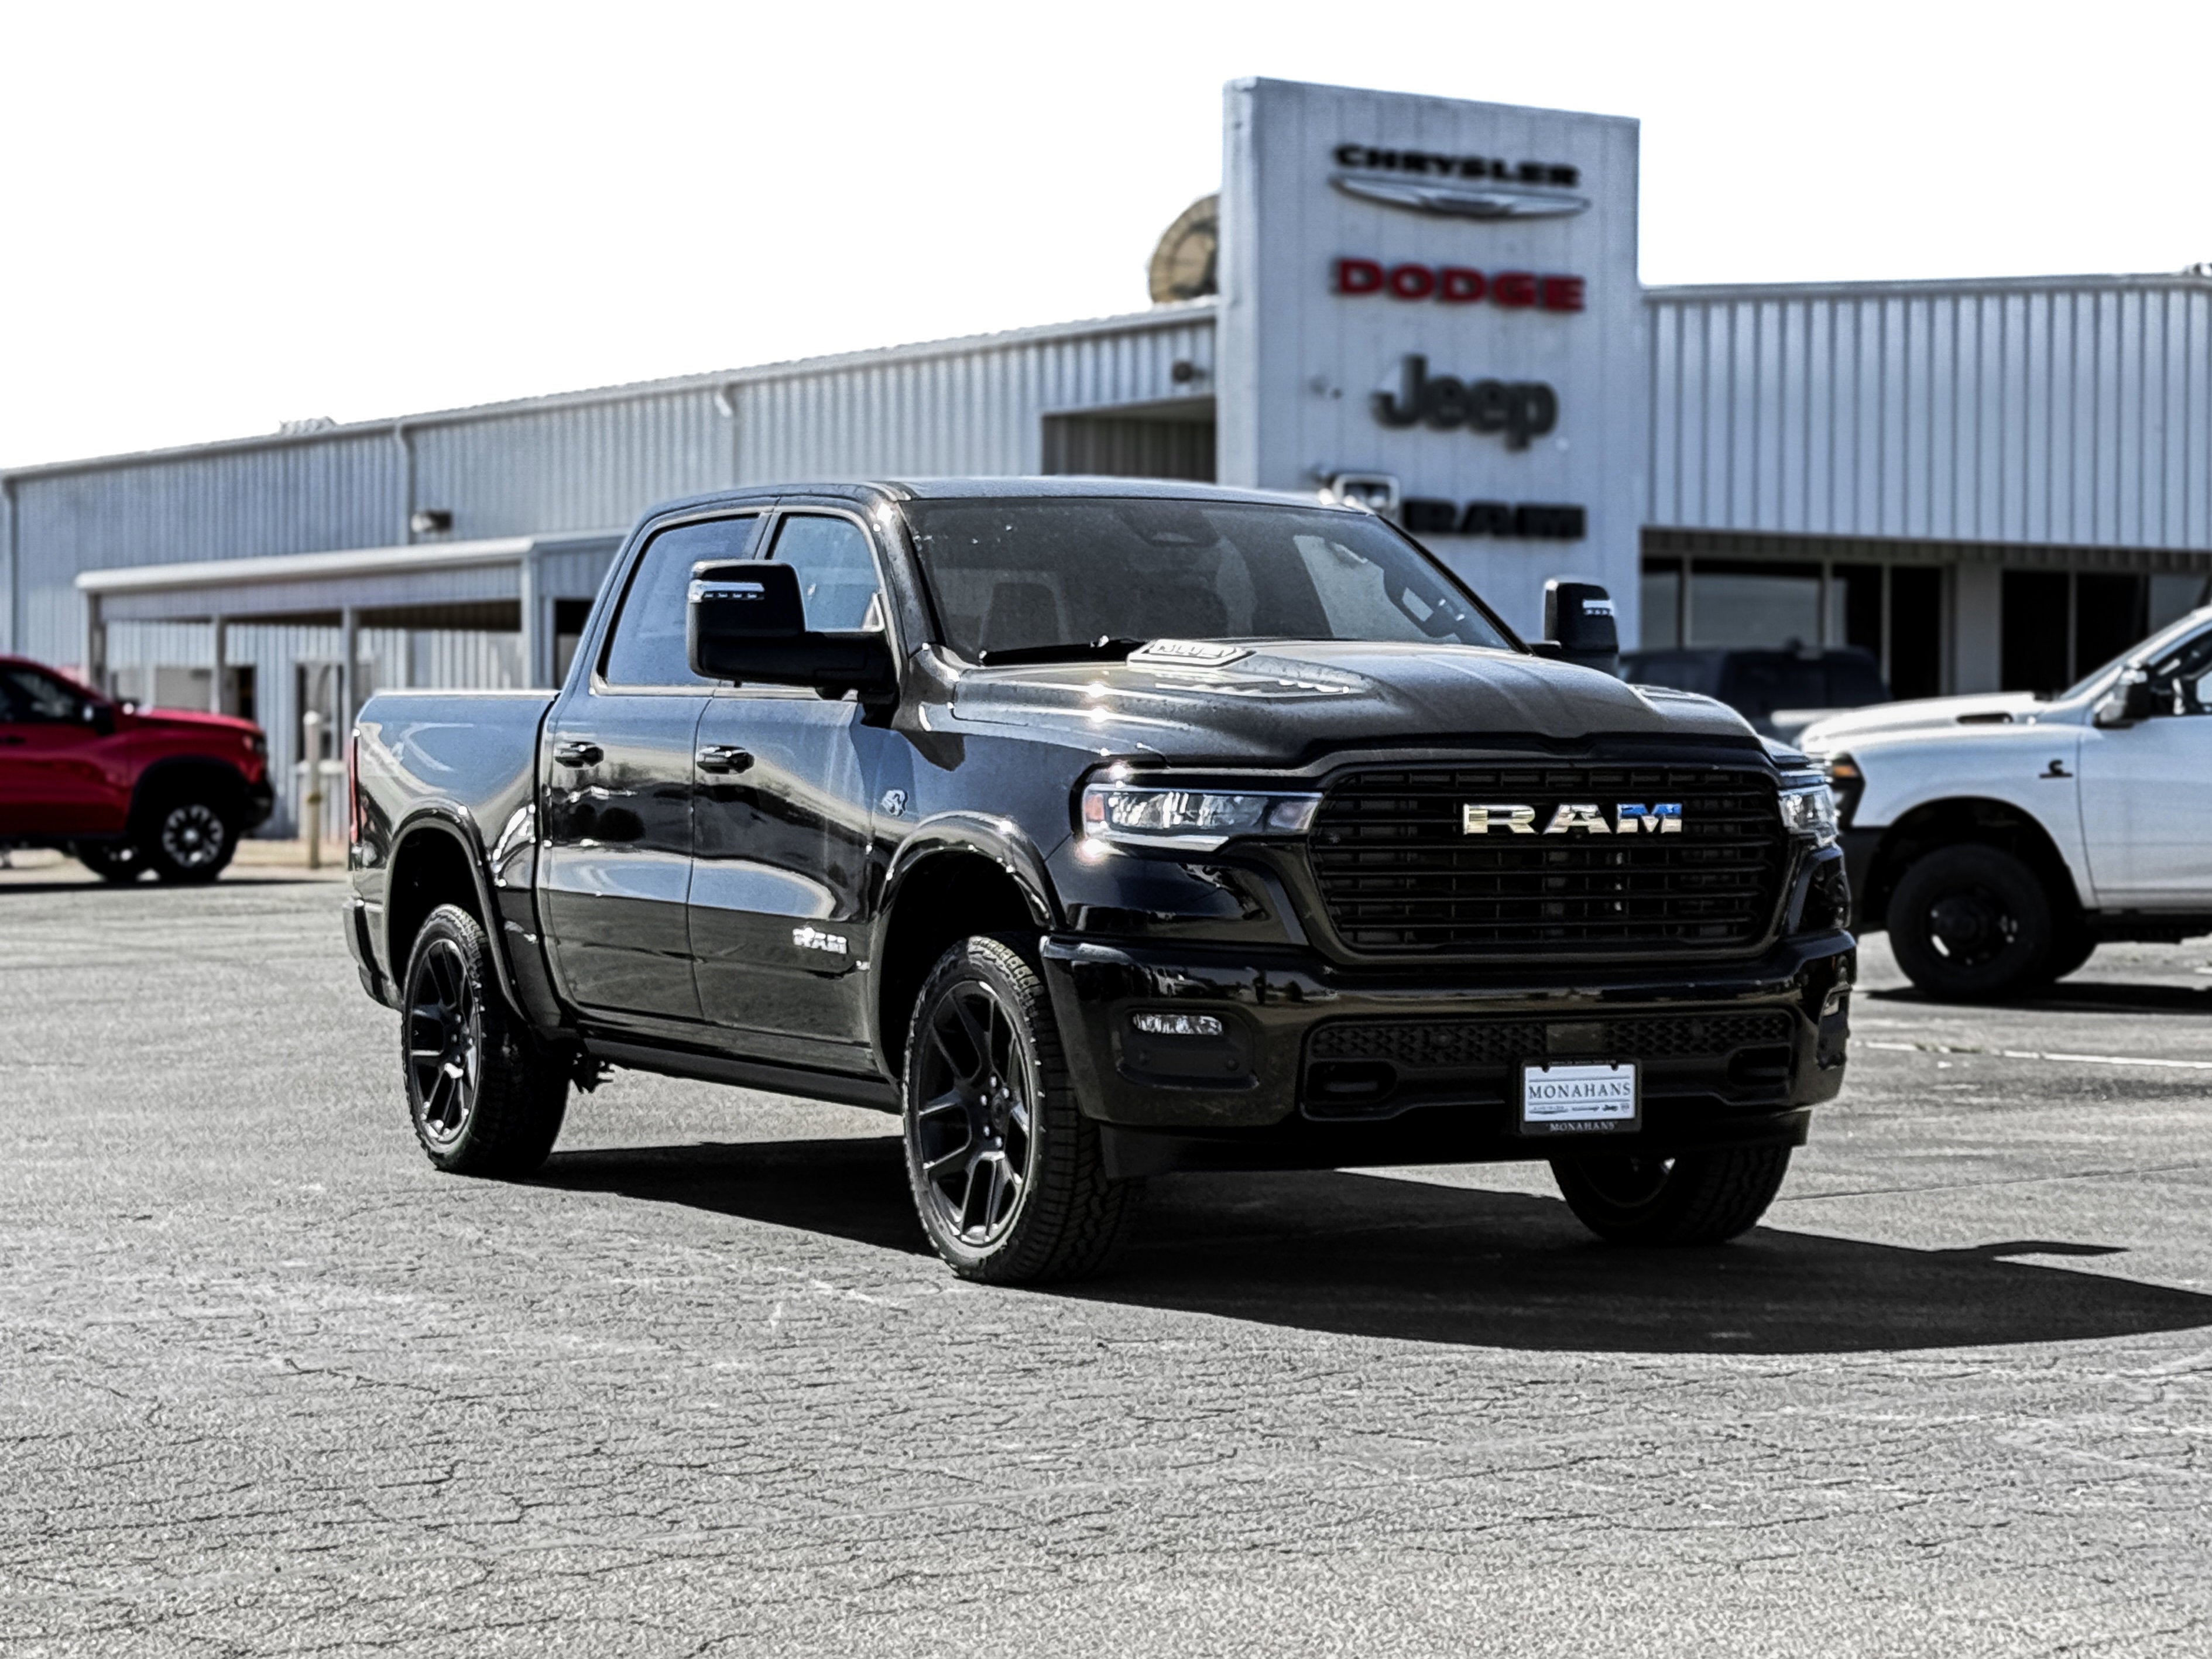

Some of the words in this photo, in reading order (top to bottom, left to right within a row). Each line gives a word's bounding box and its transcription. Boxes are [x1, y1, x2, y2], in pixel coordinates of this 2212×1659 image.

[1335, 144, 1579, 187] CHRYSLER
[1333, 258, 1585, 311] DODGE
[1370, 354, 1558, 453] Jeep
[1401, 498, 1586, 540] RAM
[1463, 803, 1683, 835] RAM
[1529, 1083, 1631, 1099] MONAHANS
